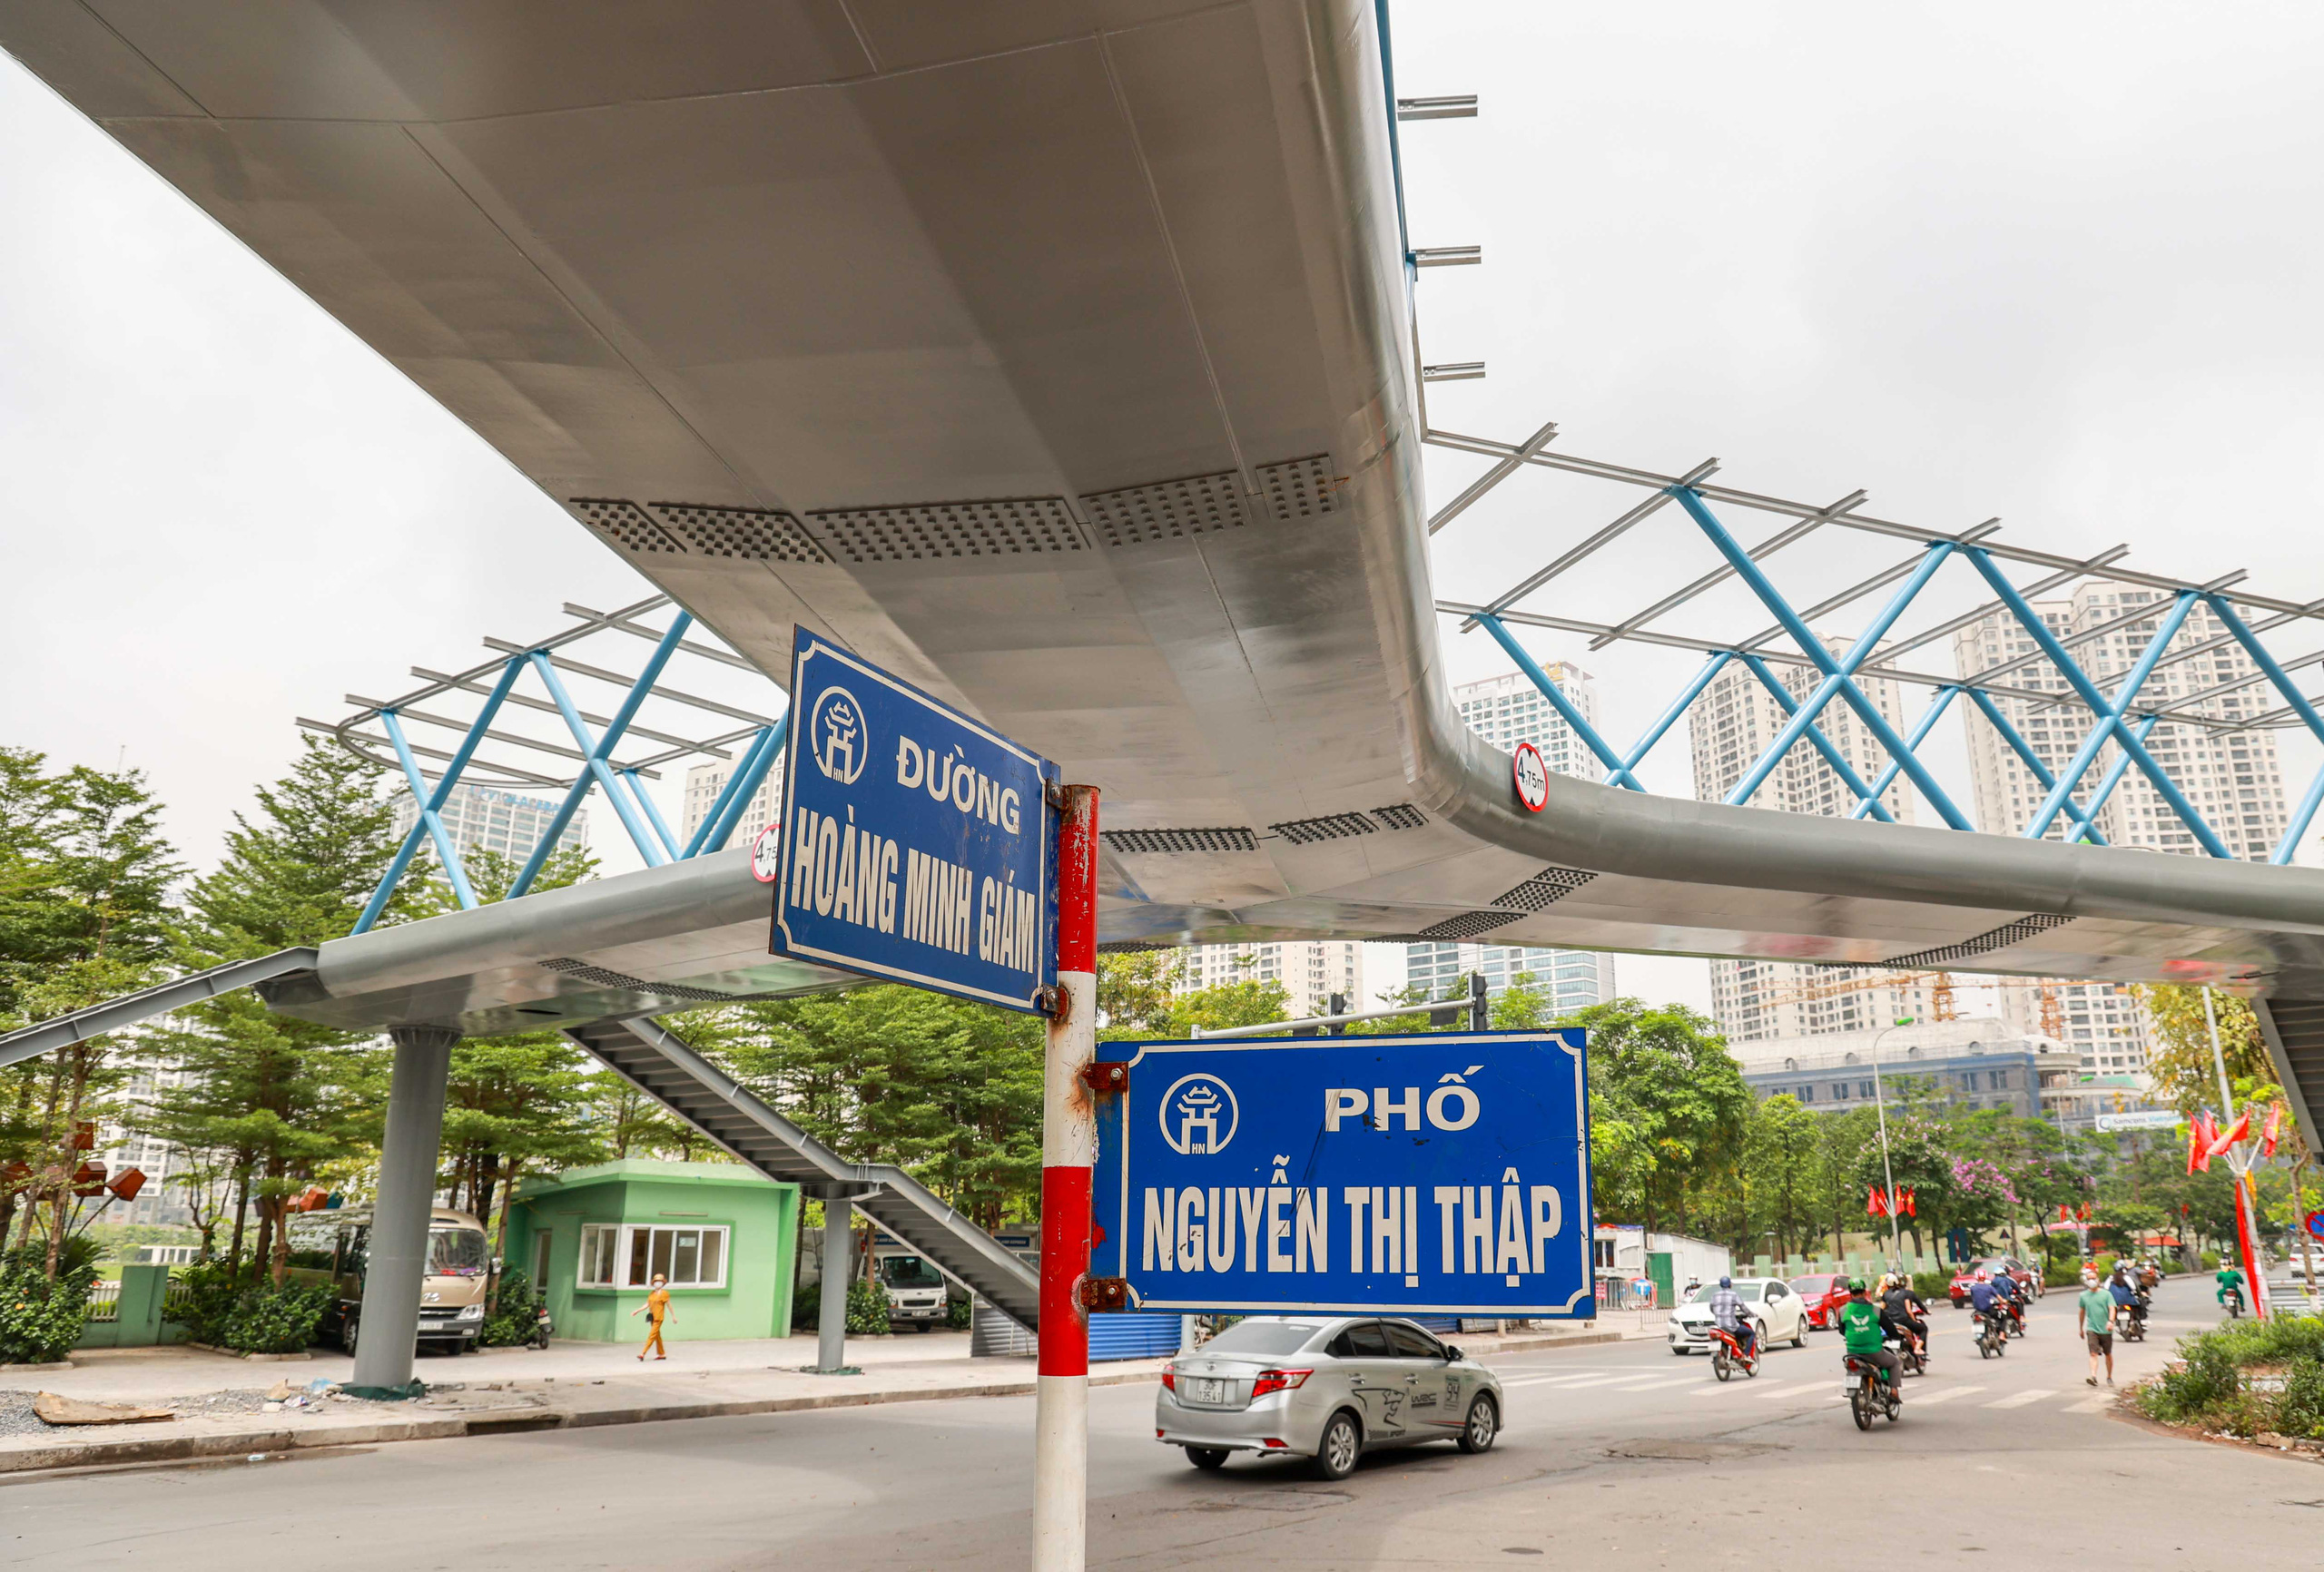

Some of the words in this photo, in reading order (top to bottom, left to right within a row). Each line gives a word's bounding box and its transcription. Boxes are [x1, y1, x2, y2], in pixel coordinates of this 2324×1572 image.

[896, 735, 1020, 834] ĐƯỜNG
[791, 804, 899, 935] HOÀNG
[903, 848, 972, 956] MINH
[979, 870, 1036, 974] GIÁM
[1324, 1065, 1485, 1133] PHỐ
[1192, 1144, 1206, 1154] HN
[1142, 1154, 1328, 1273] NGUYỄN
[1344, 1185, 1420, 1288] THỊ
[1433, 1167, 1562, 1288] THẬP
